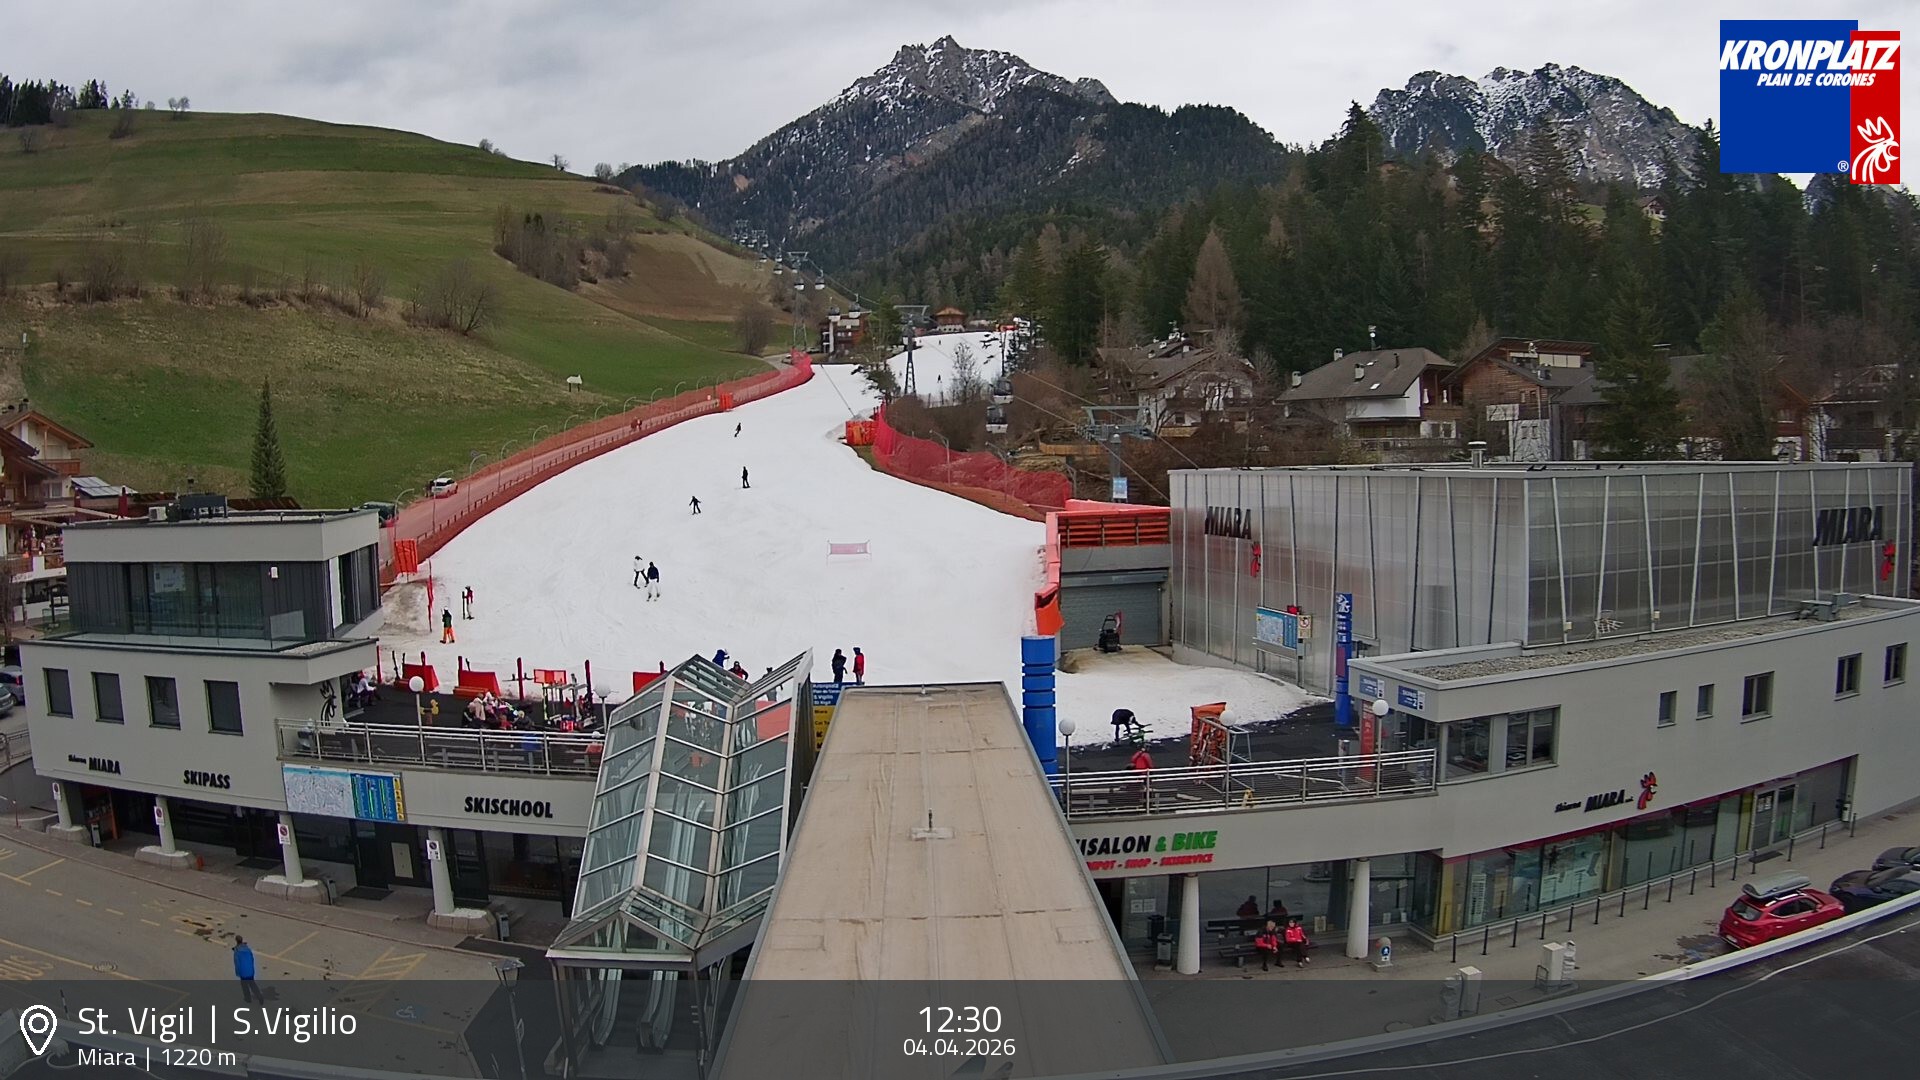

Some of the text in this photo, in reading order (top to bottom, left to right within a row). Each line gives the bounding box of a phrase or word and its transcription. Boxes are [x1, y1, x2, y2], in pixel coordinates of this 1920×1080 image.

[1204, 506, 1251, 539] MIARA
[1813, 505, 1884, 546] MIARA
[88, 757, 121, 775] MIARA
[183, 770, 231, 789] SKIPASS
[464, 796, 553, 818] SKISCHOOL
[1584, 789, 1625, 813] MIARA
[1076, 830, 1218, 856] ISALON & BIKE
